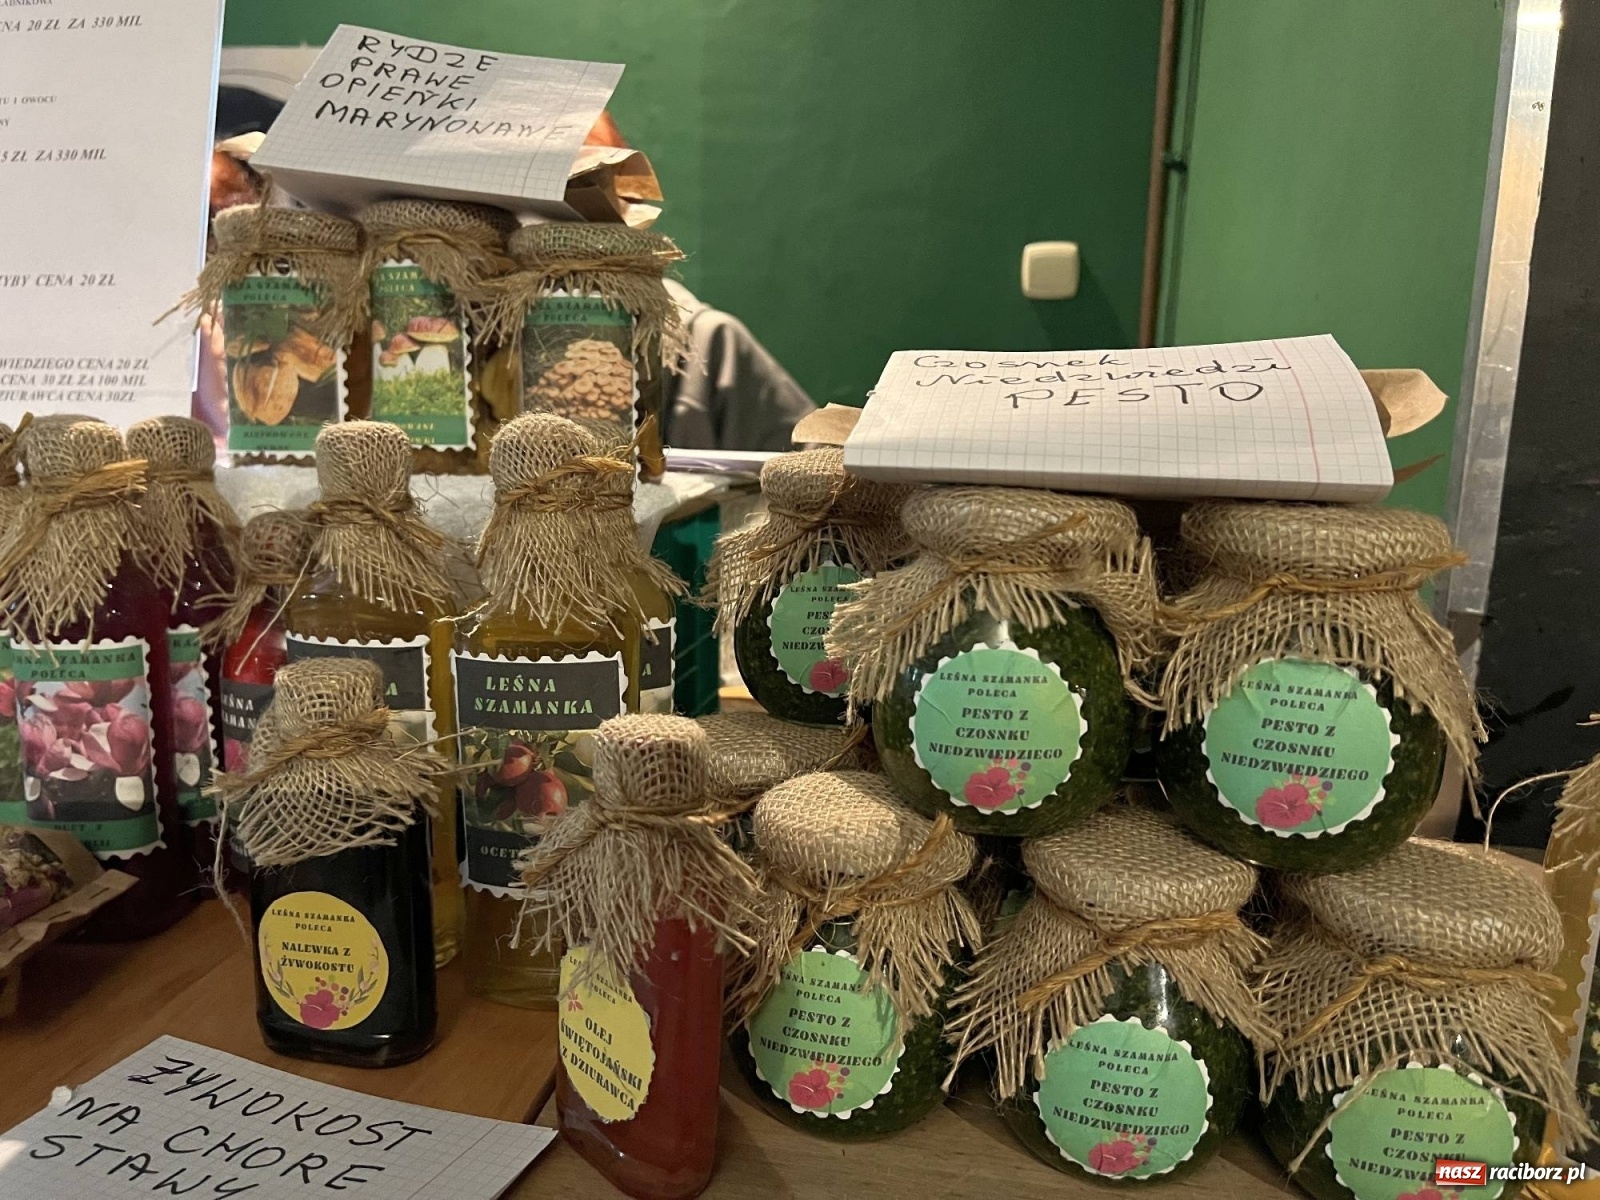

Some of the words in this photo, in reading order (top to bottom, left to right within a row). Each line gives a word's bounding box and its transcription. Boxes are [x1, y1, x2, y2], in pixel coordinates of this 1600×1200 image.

[27, 19, 42, 31] 20
[67, 18, 86, 29] ZA
[92, 16, 114, 28] 330
[116, 15, 143, 27] MIL
[357, 34, 499, 72] RYDZE
[350, 56, 476, 89] PRAWE
[22, 95, 57, 105] OWOCU
[35, 150, 53, 162] ZA
[55, 149, 78, 161] 330
[80, 148, 107, 160] MIL
[35, 274, 74, 286] CENA
[80, 274, 96, 286] 20
[77, 358, 113, 370] CENA
[116, 359, 131, 370] 20
[1, 374, 36, 385] CENA
[42, 374, 56, 385] 30
[77, 374, 95, 385] ZA
[98, 374, 118, 385] 100
[120, 374, 147, 386] MIL
[66, 391, 103, 402] CENA
[1004, 381, 1264, 410] PESTO
[790, 584, 818, 593] LEŚNA
[58, 651, 136, 666] ZAMANKA
[30, 669, 87, 679] POLECA
[939, 671, 977, 683] LEŚNA
[982, 674, 1048, 684] SZAMANKA
[486, 674, 556, 693] LEŚNA
[1239, 679, 1281, 693] LEŚNA
[1287, 685, 1358, 700] SZAMANKA
[967, 687, 1017, 698] POLECA
[474, 697, 593, 715] SZAMANKA
[1270, 698, 1325, 712] POLECA
[961, 707, 1014, 721] PESTO
[1019, 709, 1029, 721] Z
[955, 727, 1030, 741] CZOSNKU
[1261, 717, 1319, 736] PESTO
[1324, 725, 1337, 737] Z
[928, 742, 1063, 760] NIEDZWIEDZIEGO
[1252, 737, 1336, 759] CZOSNKU
[1220, 751, 1370, 781] NIEDZWIEDZIEGO
[480, 845, 518, 858] OCET
[272, 907, 300, 918] LEŚNA
[304, 912, 356, 923] SZAMANKA
[295, 922, 333, 932] POLECA
[281, 941, 339, 956] NALEWKA
[343, 947, 351, 957] Z
[281, 955, 355, 974] ŻYWOKOSTU
[796, 989, 842, 1004] POLECA
[788, 1007, 837, 1026] PESTO
[841, 1017, 851, 1028] Z
[585, 1017, 613, 1046] OLEJ
[782, 1025, 851, 1047] CZOSNKU
[759, 1036, 883, 1067] NIEDZWIEDZIEGO
[1069, 1039, 1108, 1055] LEŚNA
[1113, 1049, 1179, 1062] SZAMANKA
[1098, 1060, 1149, 1075] POLECA
[562, 1044, 568, 1059] Z
[570, 1052, 635, 1112] DZIURAWCA
[1090, 1079, 1144, 1098] PESTO
[1149, 1087, 1160, 1099] Z
[1082, 1097, 1159, 1118] CZOSNKU
[1413, 1095, 1485, 1106] SZAMANKA
[1053, 1106, 1190, 1136] NIEDZWIEDZIEGO
[1397, 1107, 1453, 1121] POLECA
[57, 1096, 142, 1135] NA
[163, 1125, 386, 1191] CHORE
[1390, 1127, 1450, 1145] PESTO
[1454, 1133, 1466, 1145] Z
[29, 1134, 259, 1200] STAWY
